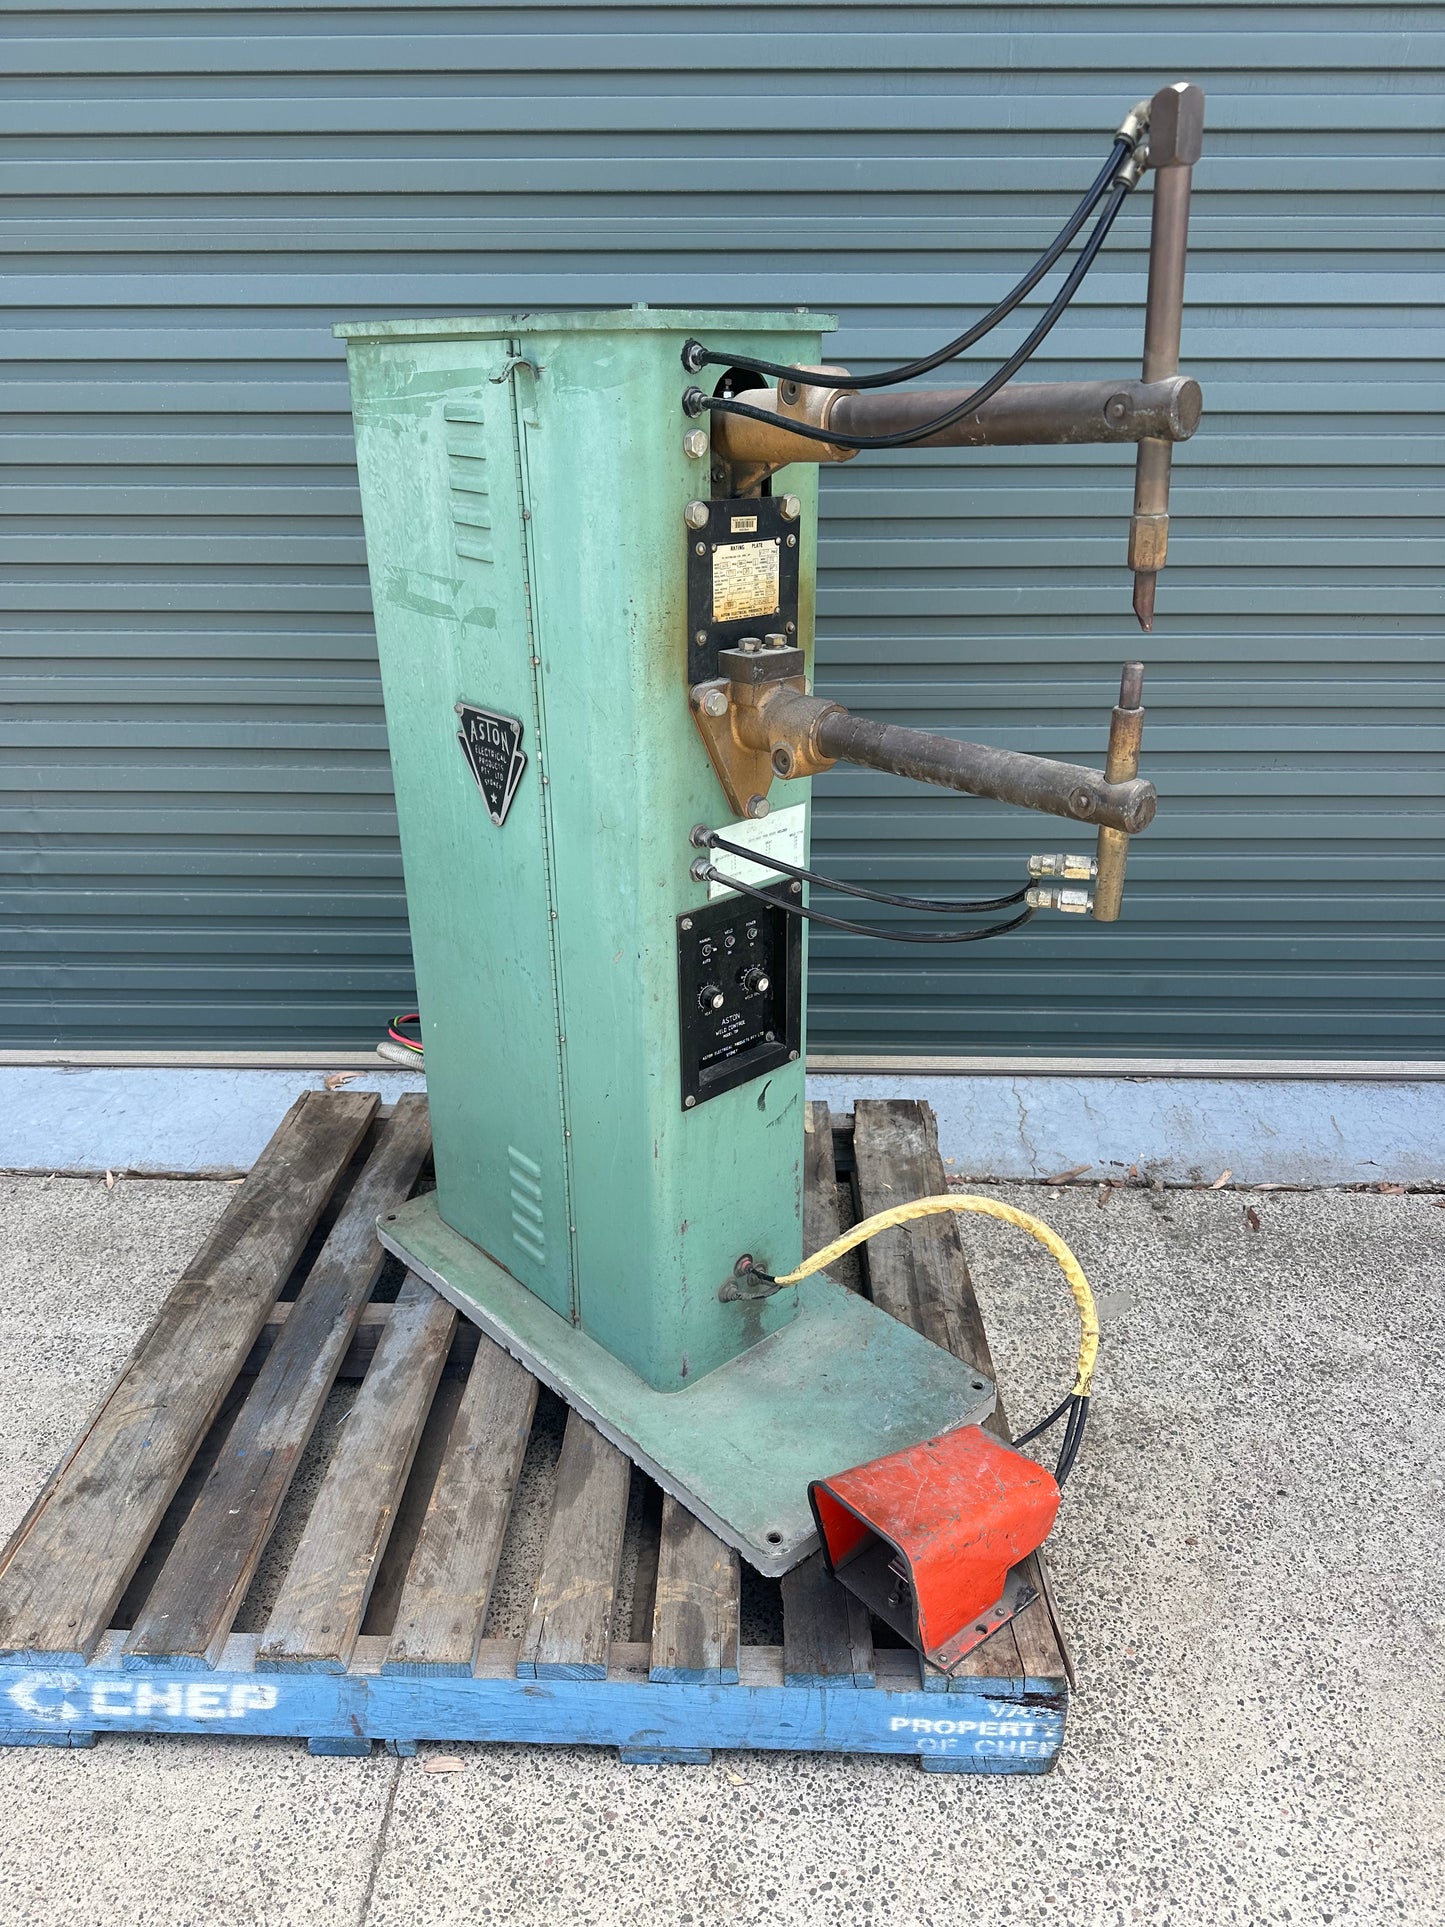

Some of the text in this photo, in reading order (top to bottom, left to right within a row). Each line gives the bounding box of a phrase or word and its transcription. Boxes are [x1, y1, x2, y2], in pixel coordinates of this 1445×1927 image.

[470, 716, 510, 755] ASTON
[475, 744, 507, 764] ELECTRICAL
[478, 757, 504, 772] PRODUCTS
[484, 778, 502, 790] SYDNEY
[495, 773, 504, 781] LTD
[722, 1012, 740, 1025] ASTON
[716, 1028, 727, 1036] WELD
[728, 1020, 746, 1030] CONTROL
[91, 1681, 278, 1718] CHEP
[890, 1717, 1059, 1738] PROPERTY
[916, 1737, 958, 1752] OF
